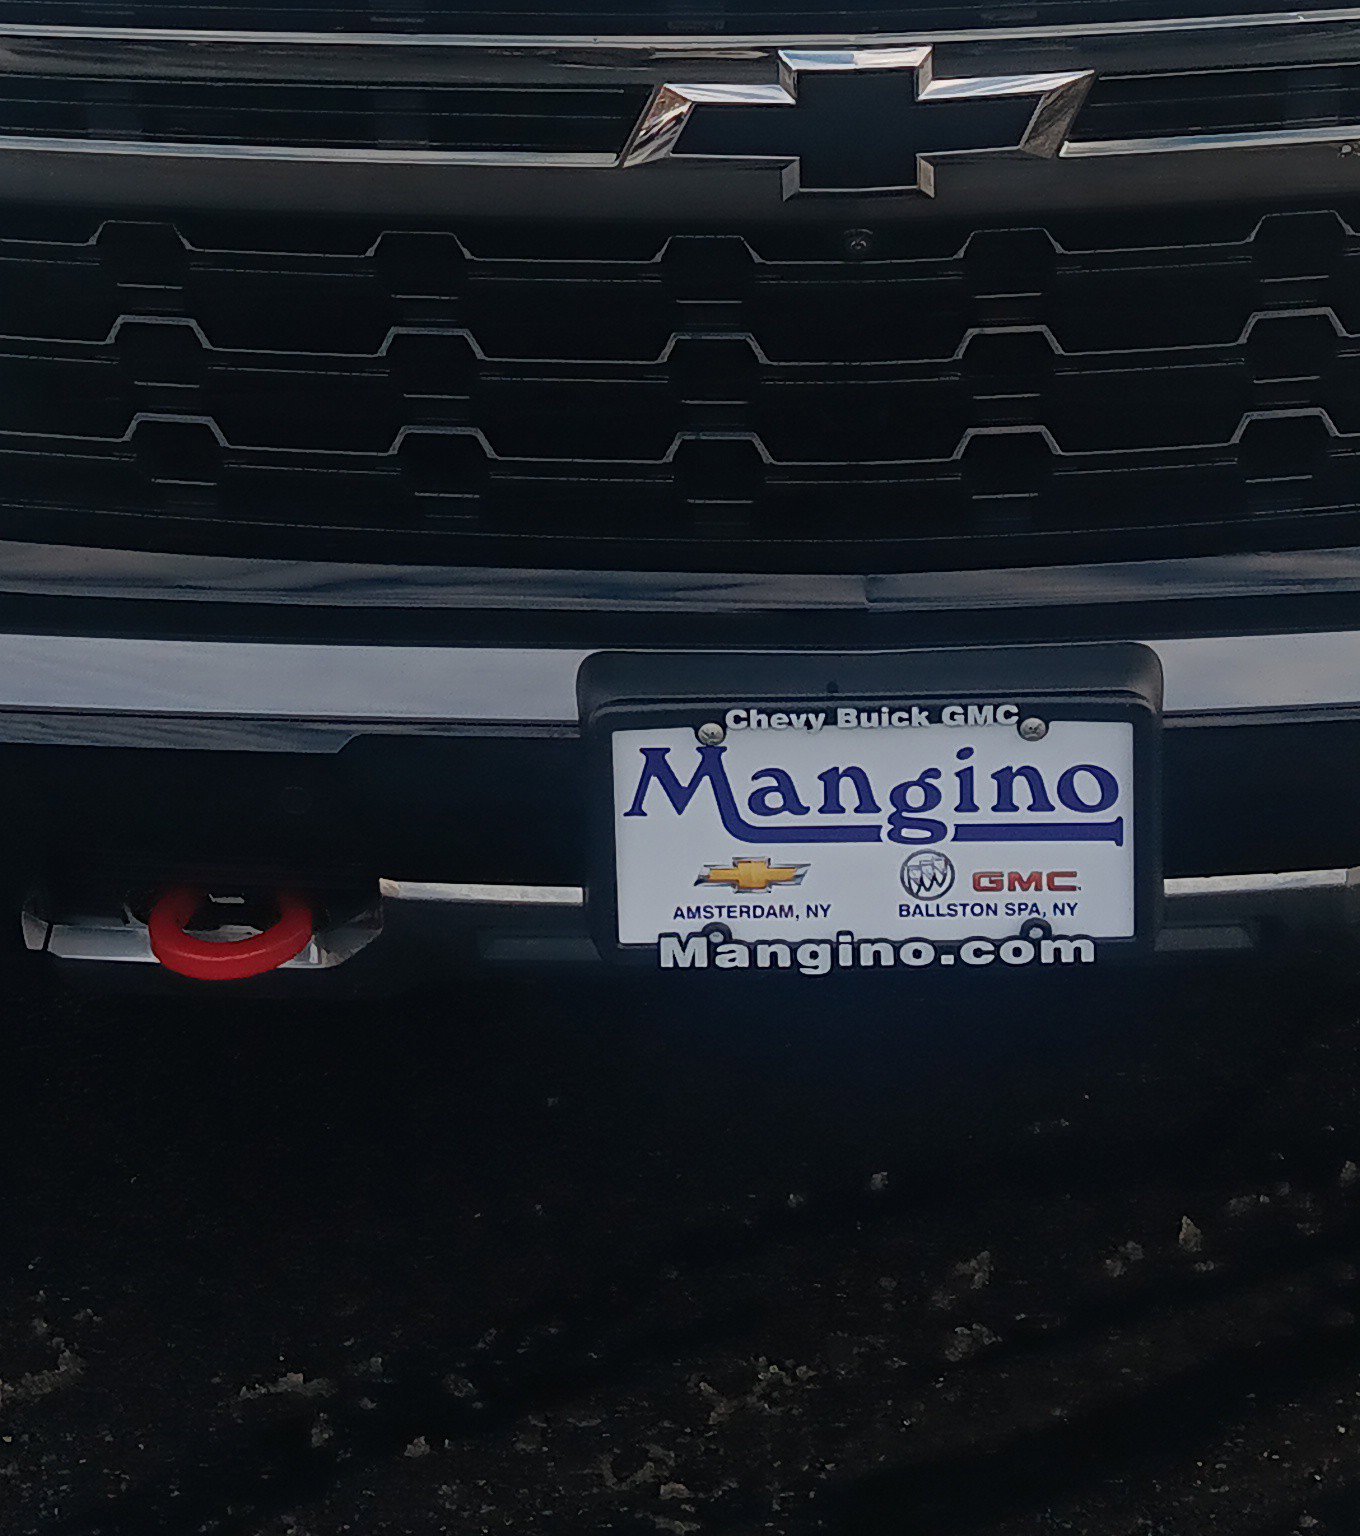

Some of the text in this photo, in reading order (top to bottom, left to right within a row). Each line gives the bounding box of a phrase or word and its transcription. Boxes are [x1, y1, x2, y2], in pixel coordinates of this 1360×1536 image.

[725, 704, 1020, 734] Chevy Buick GMC
[623, 745, 1124, 846] Mangino
[971, 870, 1078, 893] GMC
[673, 903, 832, 921] AMSTERDAM, NY
[898, 901, 1079, 919] BALLSTON SPA, NY
[659, 933, 1095, 976] Mangino.com
